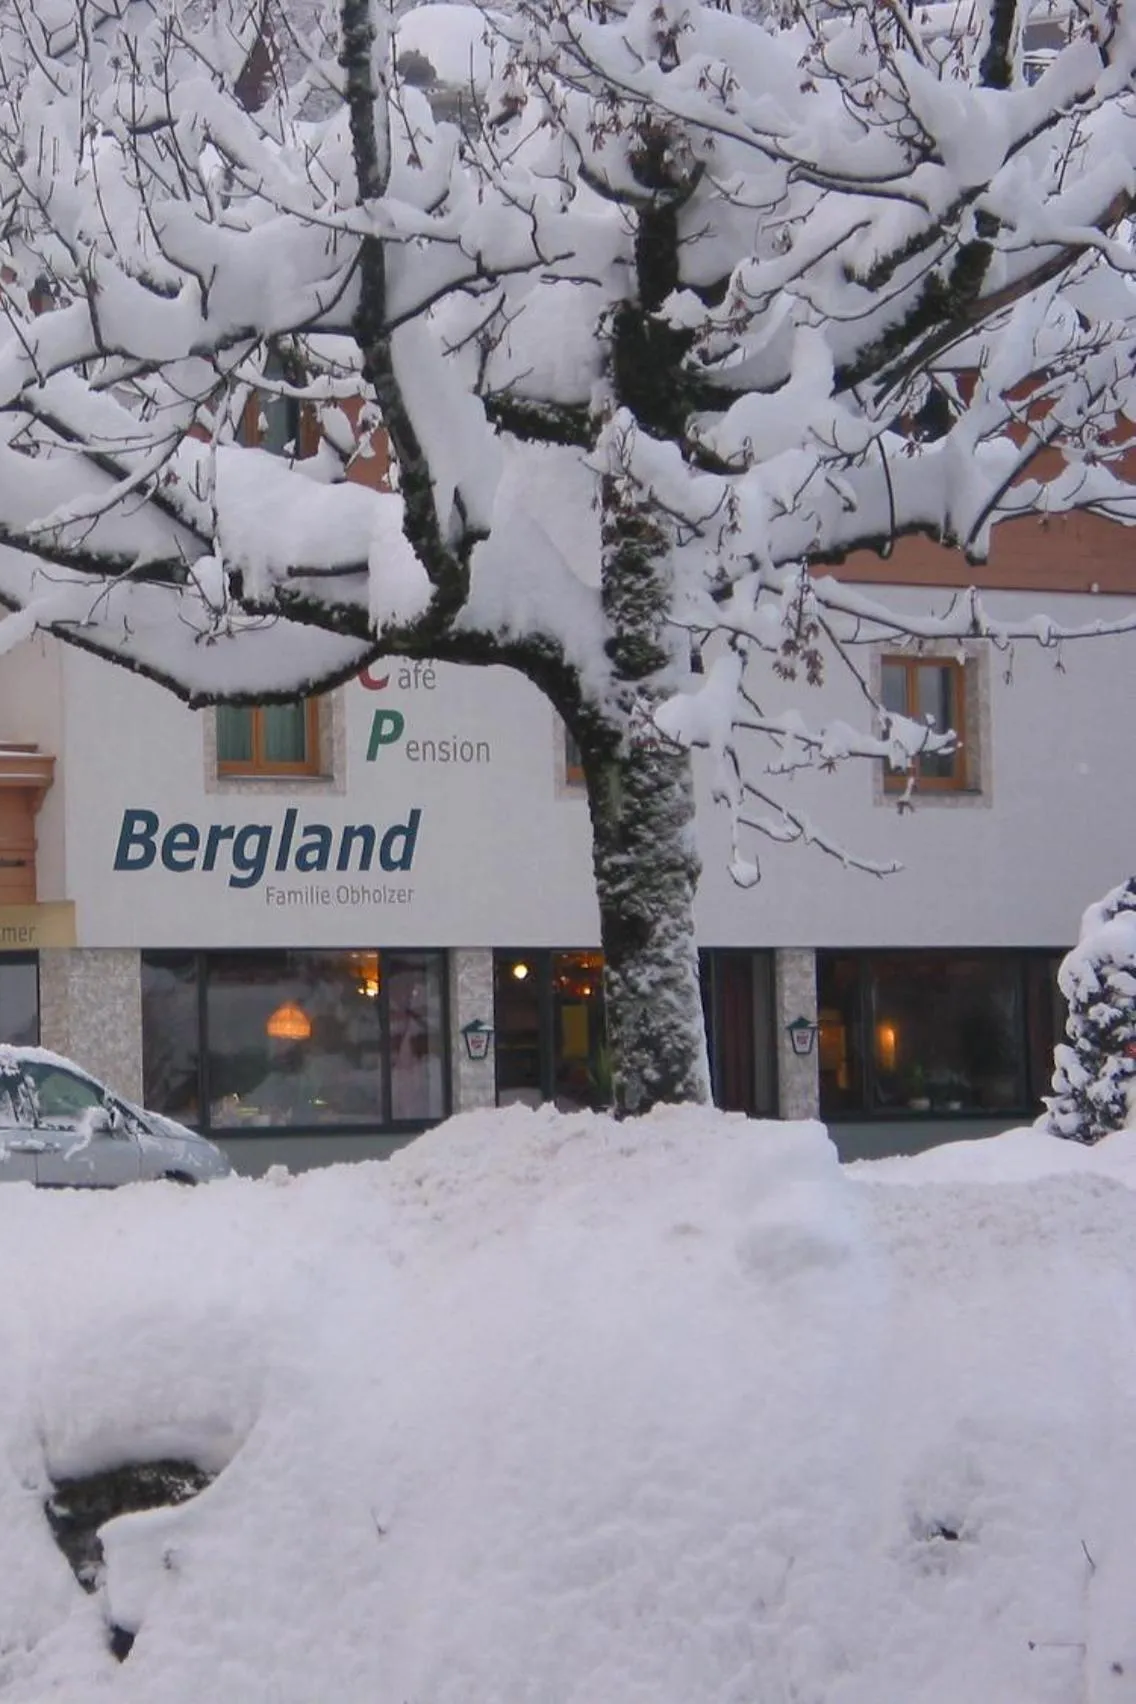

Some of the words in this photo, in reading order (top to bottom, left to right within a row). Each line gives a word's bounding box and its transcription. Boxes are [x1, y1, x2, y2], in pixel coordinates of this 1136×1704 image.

[366, 708, 490, 762] Pension
[113, 808, 423, 889] Bergland
[266, 886, 330, 904] Familie
[336, 885, 414, 904] Obholzer
